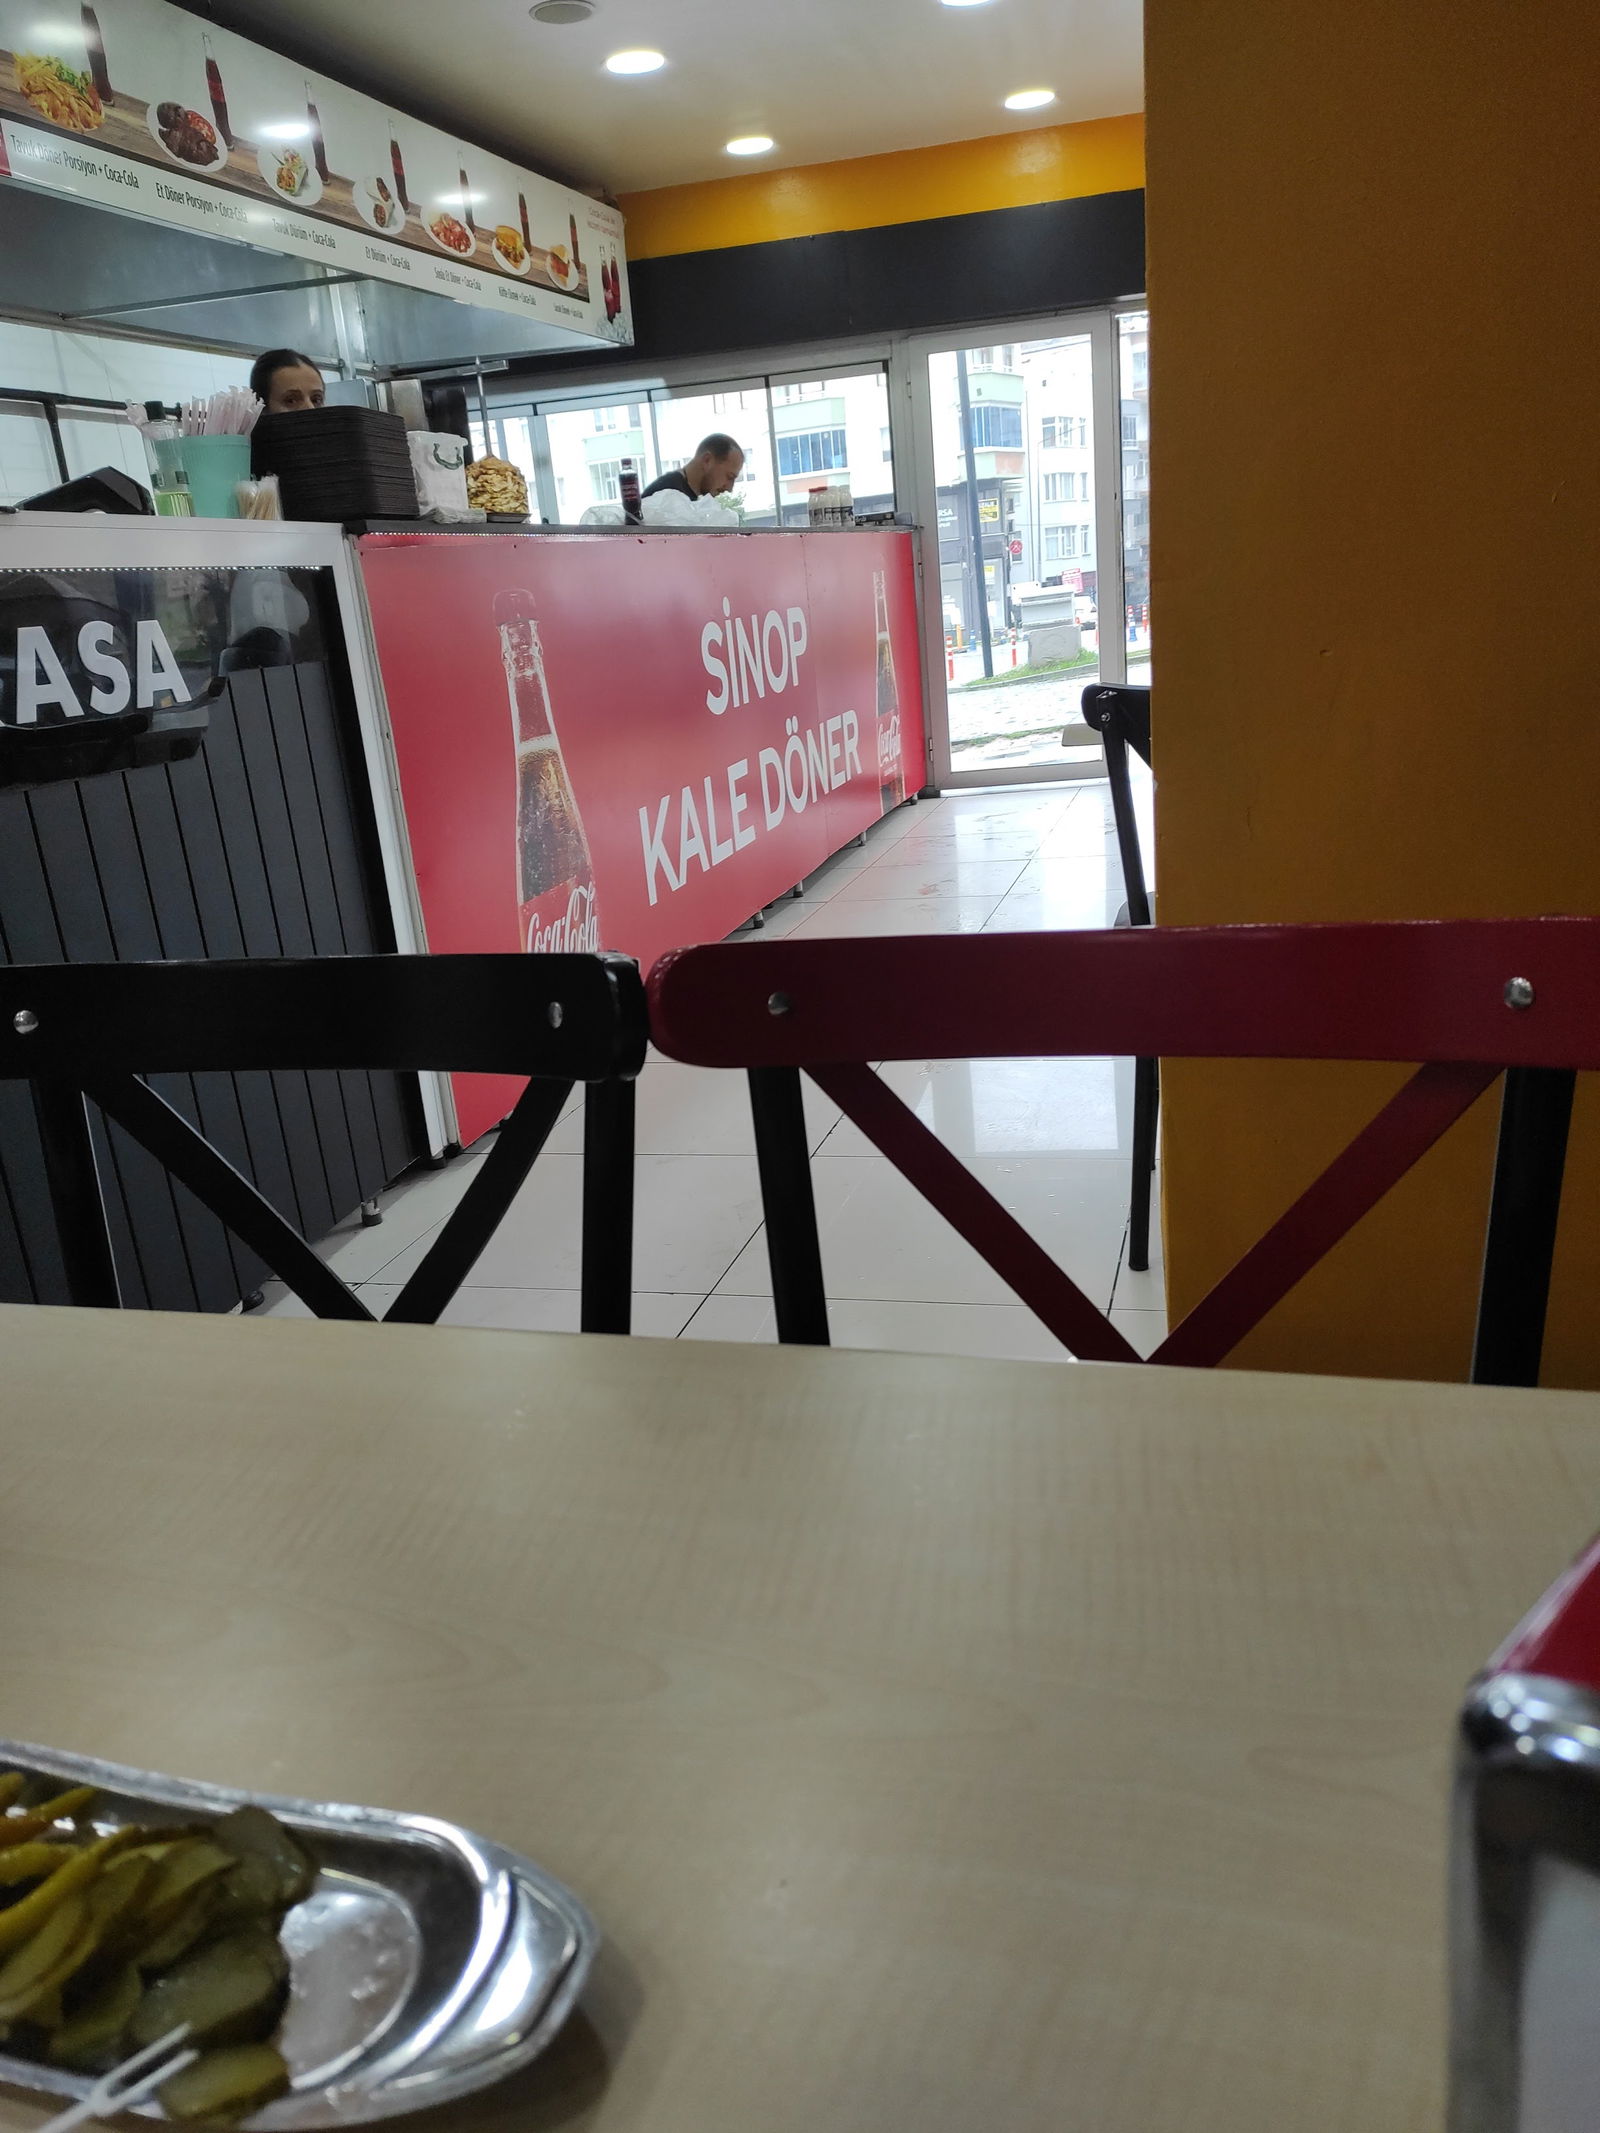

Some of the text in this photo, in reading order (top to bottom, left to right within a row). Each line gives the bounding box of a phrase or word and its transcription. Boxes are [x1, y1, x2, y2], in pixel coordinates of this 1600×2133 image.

[10, 134, 38, 158] Tavuk
[38, 142, 63, 166] Döner
[63, 151, 98, 177] Porsiyon
[104, 164, 140, 189] Coca-Cola
[155, 182, 165, 199] Et
[164, 184, 185, 205] Döner
[185, 191, 214, 214] Porsiyon
[219, 202, 248, 223] Coca-Cola
[272, 218, 290, 236] Tavuk
[289, 223, 309, 241] Dürüm
[312, 230, 337, 249] Coca-Cola
[365, 246, 372, 259] Et
[389, 254, 411, 271] Coca-Cola
[0, 620, 192, 728] ASA
[701, 596, 808, 716] SİNOP
[639, 709, 863, 907] KALE DÖNER
